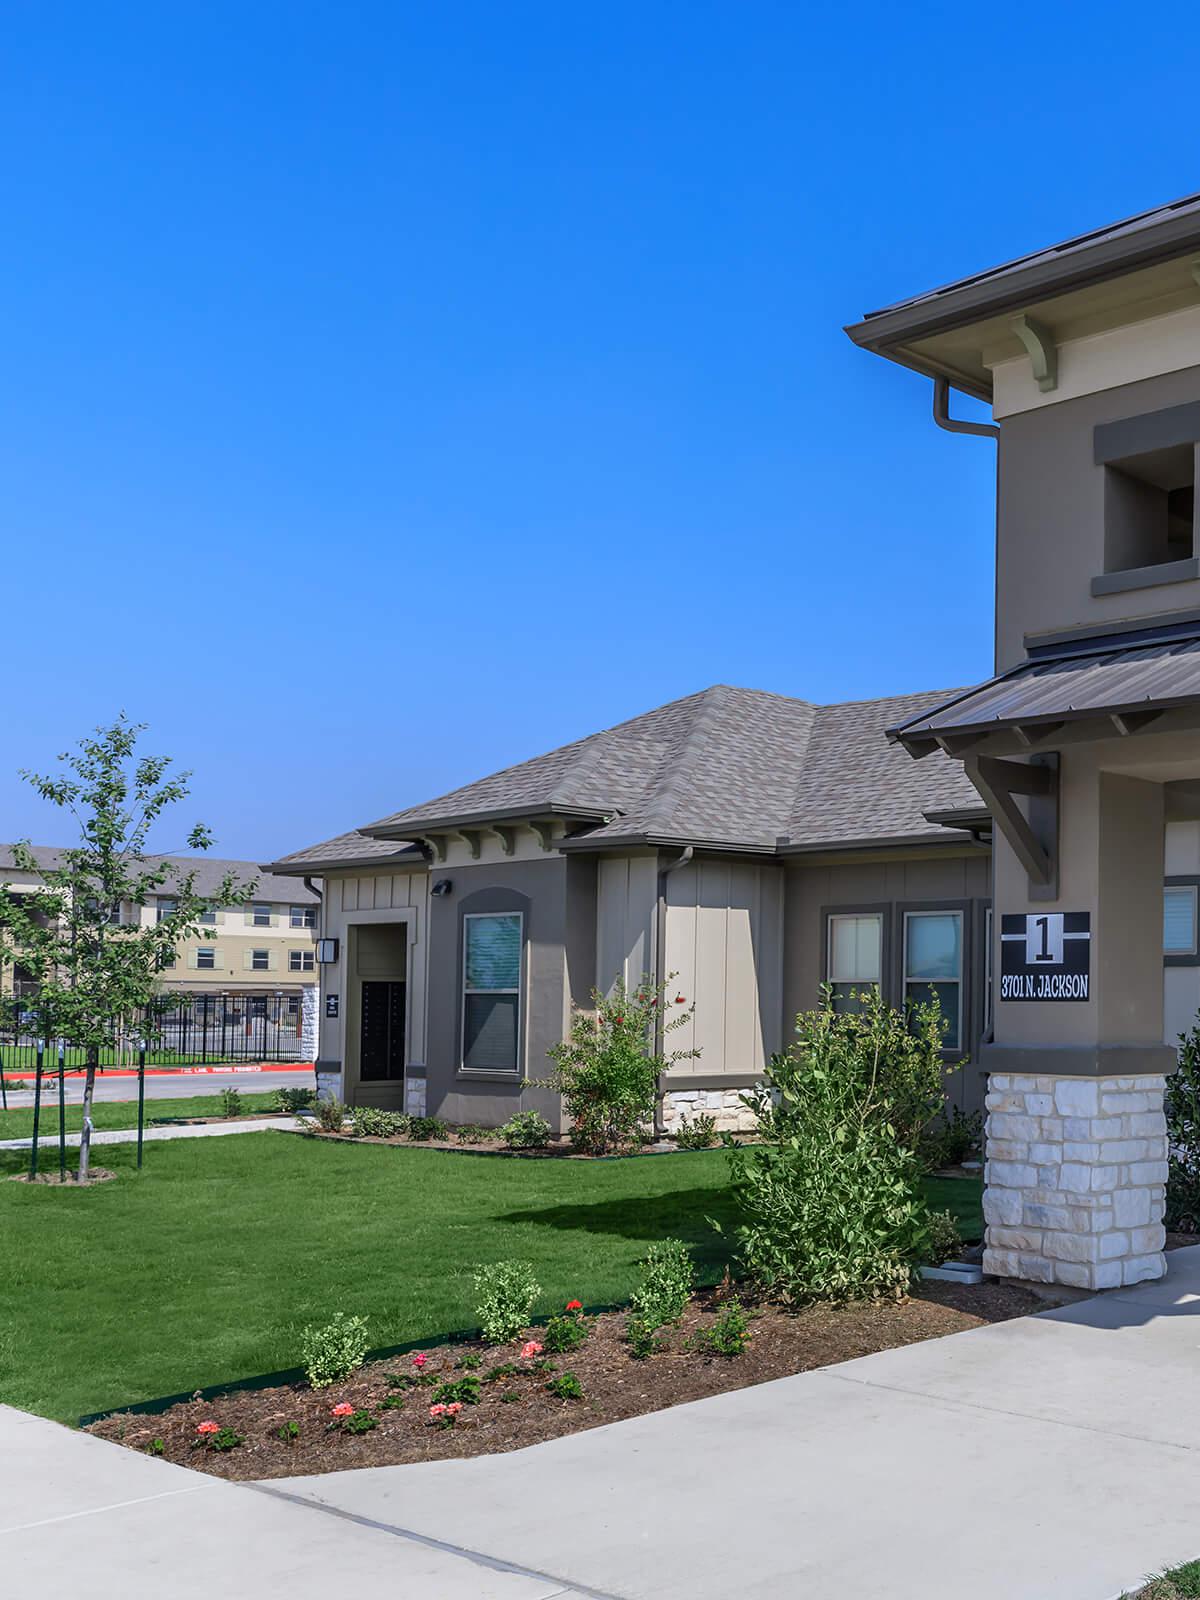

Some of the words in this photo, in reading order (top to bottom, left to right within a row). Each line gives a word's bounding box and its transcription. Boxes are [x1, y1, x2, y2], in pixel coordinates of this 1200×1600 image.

[1036, 917, 1053, 961] 1
[1001, 975, 1024, 998] 3701
[1025, 975, 1036, 998] N.
[1037, 974, 1088, 998] JACKSON
